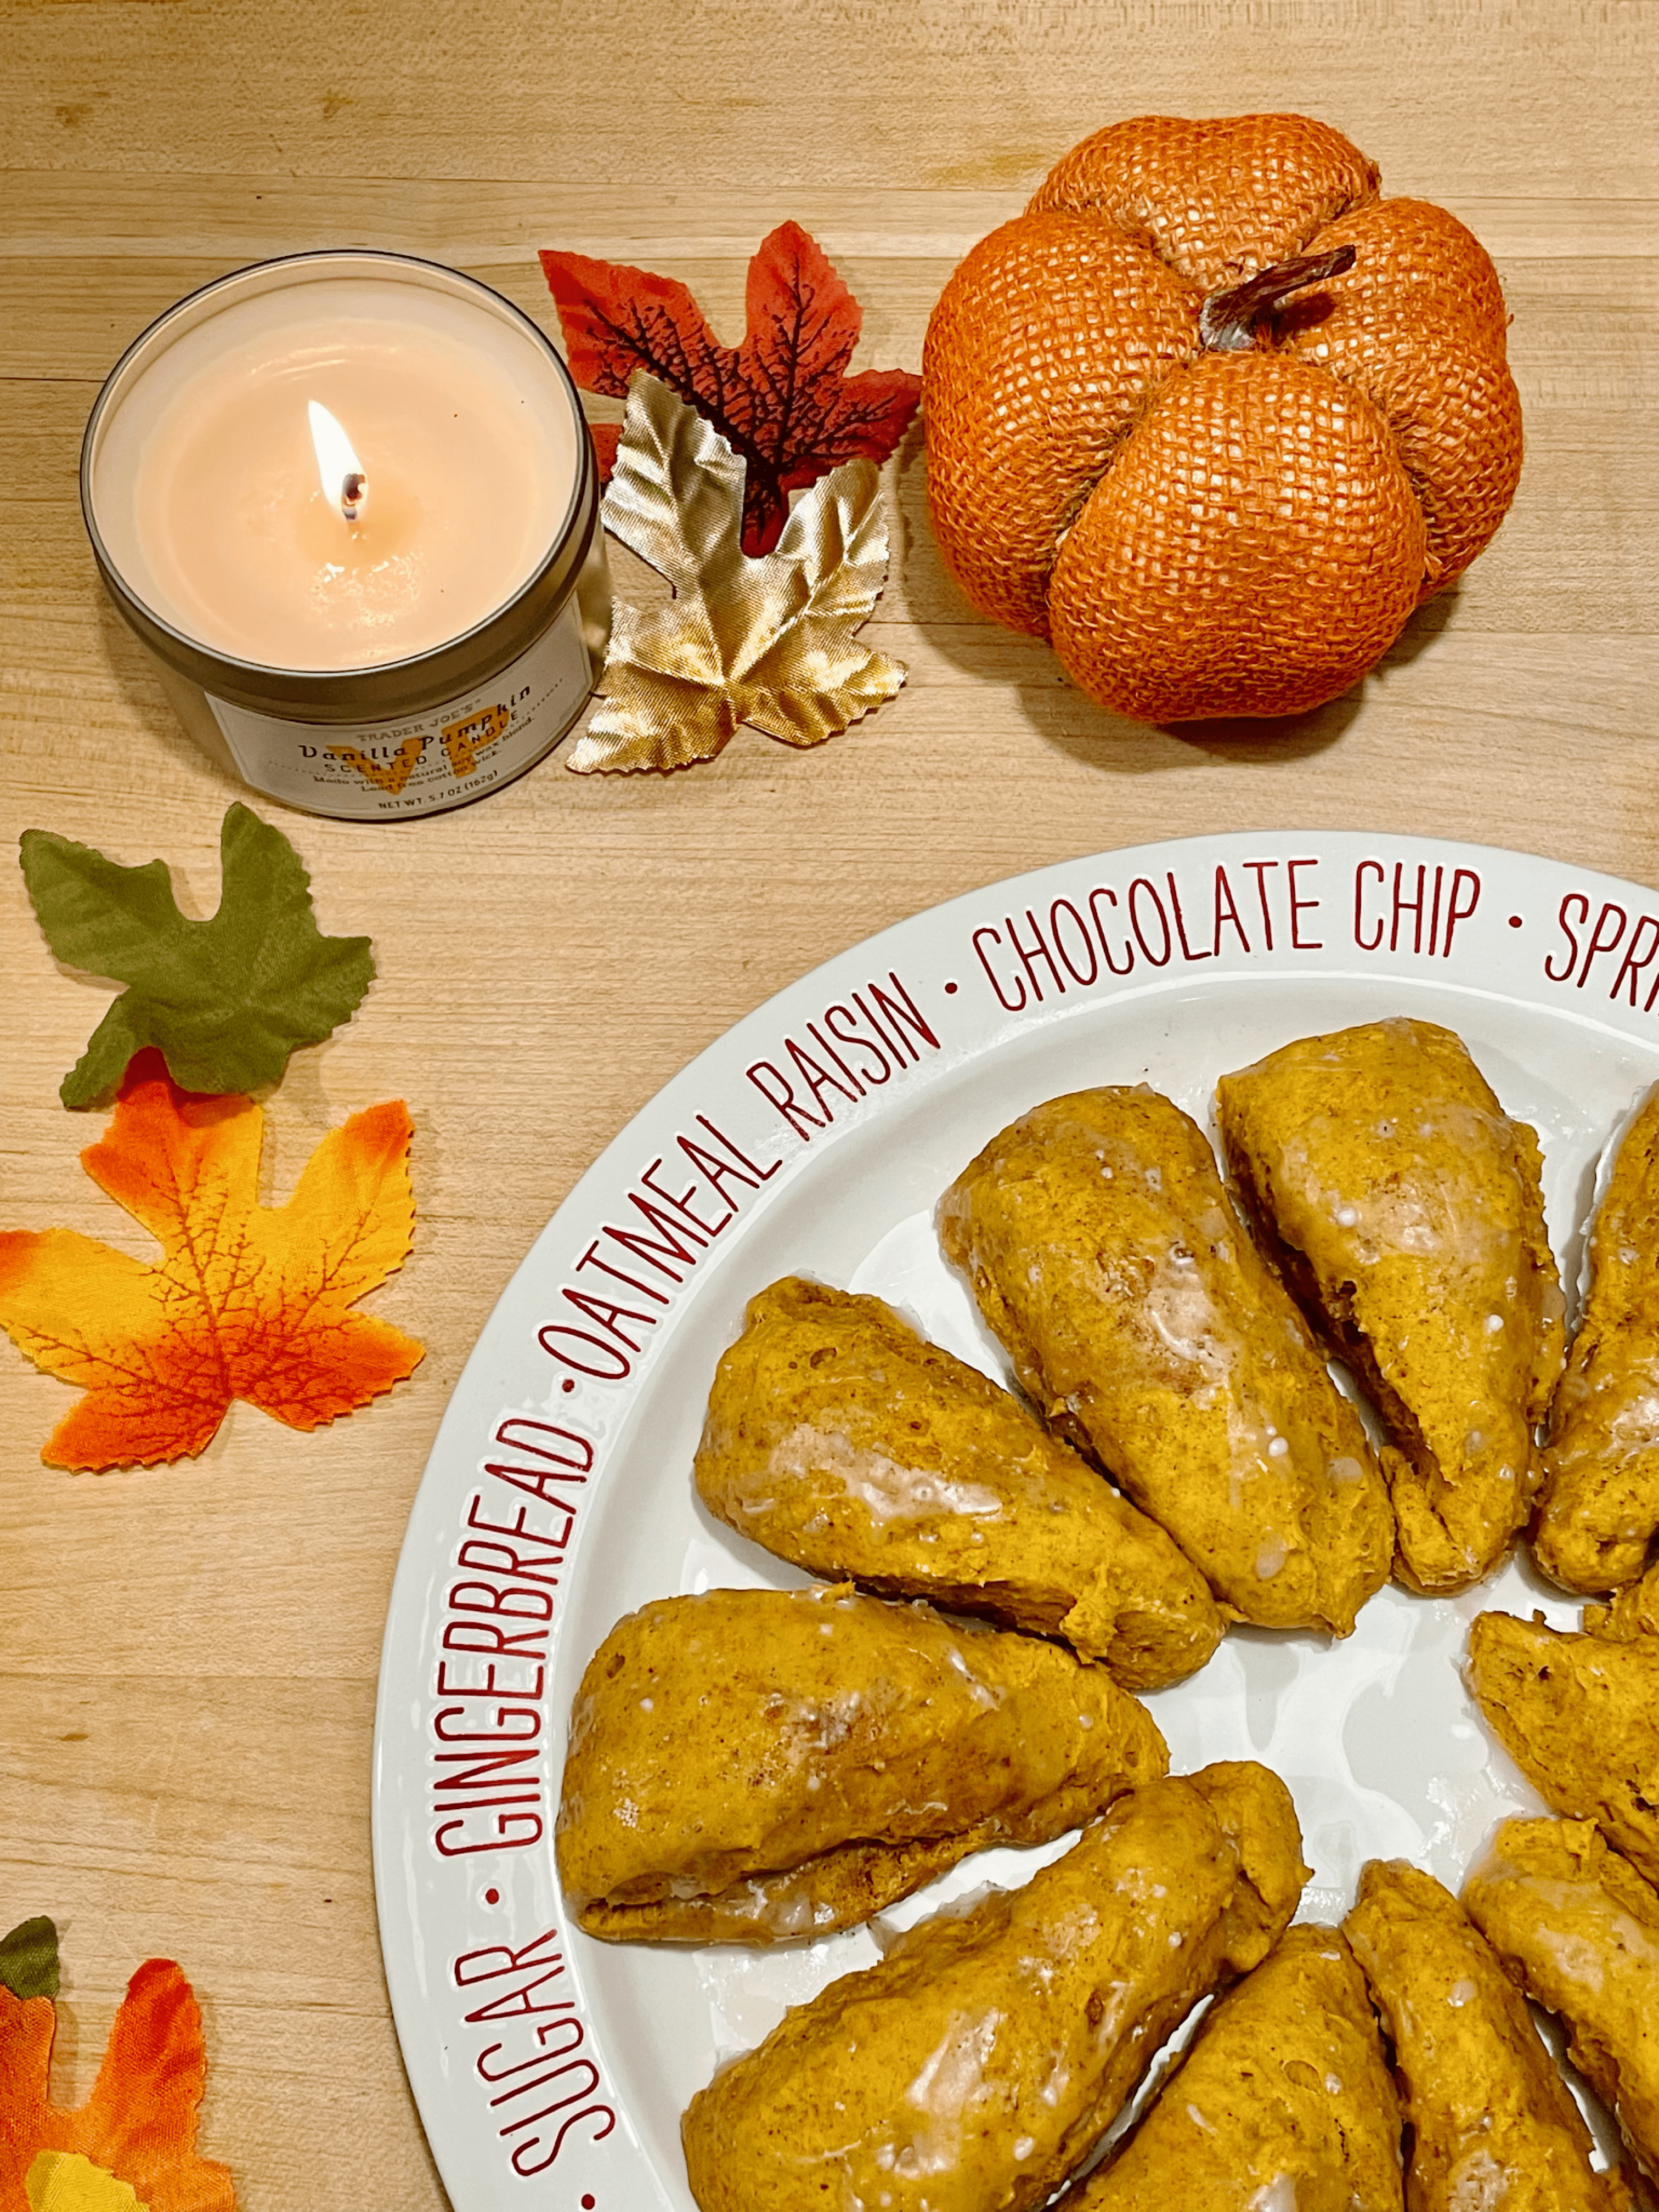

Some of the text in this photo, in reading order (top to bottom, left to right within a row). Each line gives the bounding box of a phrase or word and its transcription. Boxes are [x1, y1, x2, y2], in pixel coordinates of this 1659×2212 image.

[298, 686, 530, 760] Vanilla Pumpkin
[324, 709, 518, 772] SCENTED CANDLE
[358, 724, 425, 742] TRADER
[400, 764, 447, 781] natural
[475, 742, 499, 756] wax
[378, 801, 400, 809] NET
[448, 786, 462, 796] OZ
[465, 770, 498, 790] (162g)
[972, 859, 1323, 1012] CHOCOLATE
[1354, 860, 1481, 958] CHIP
[745, 971, 941, 1142] RAISIN
[537, 1114, 783, 1380] OATMEAL
[433, 1418, 594, 1857] GINGERBREAD
[454, 1928, 616, 2177] SUGAR
